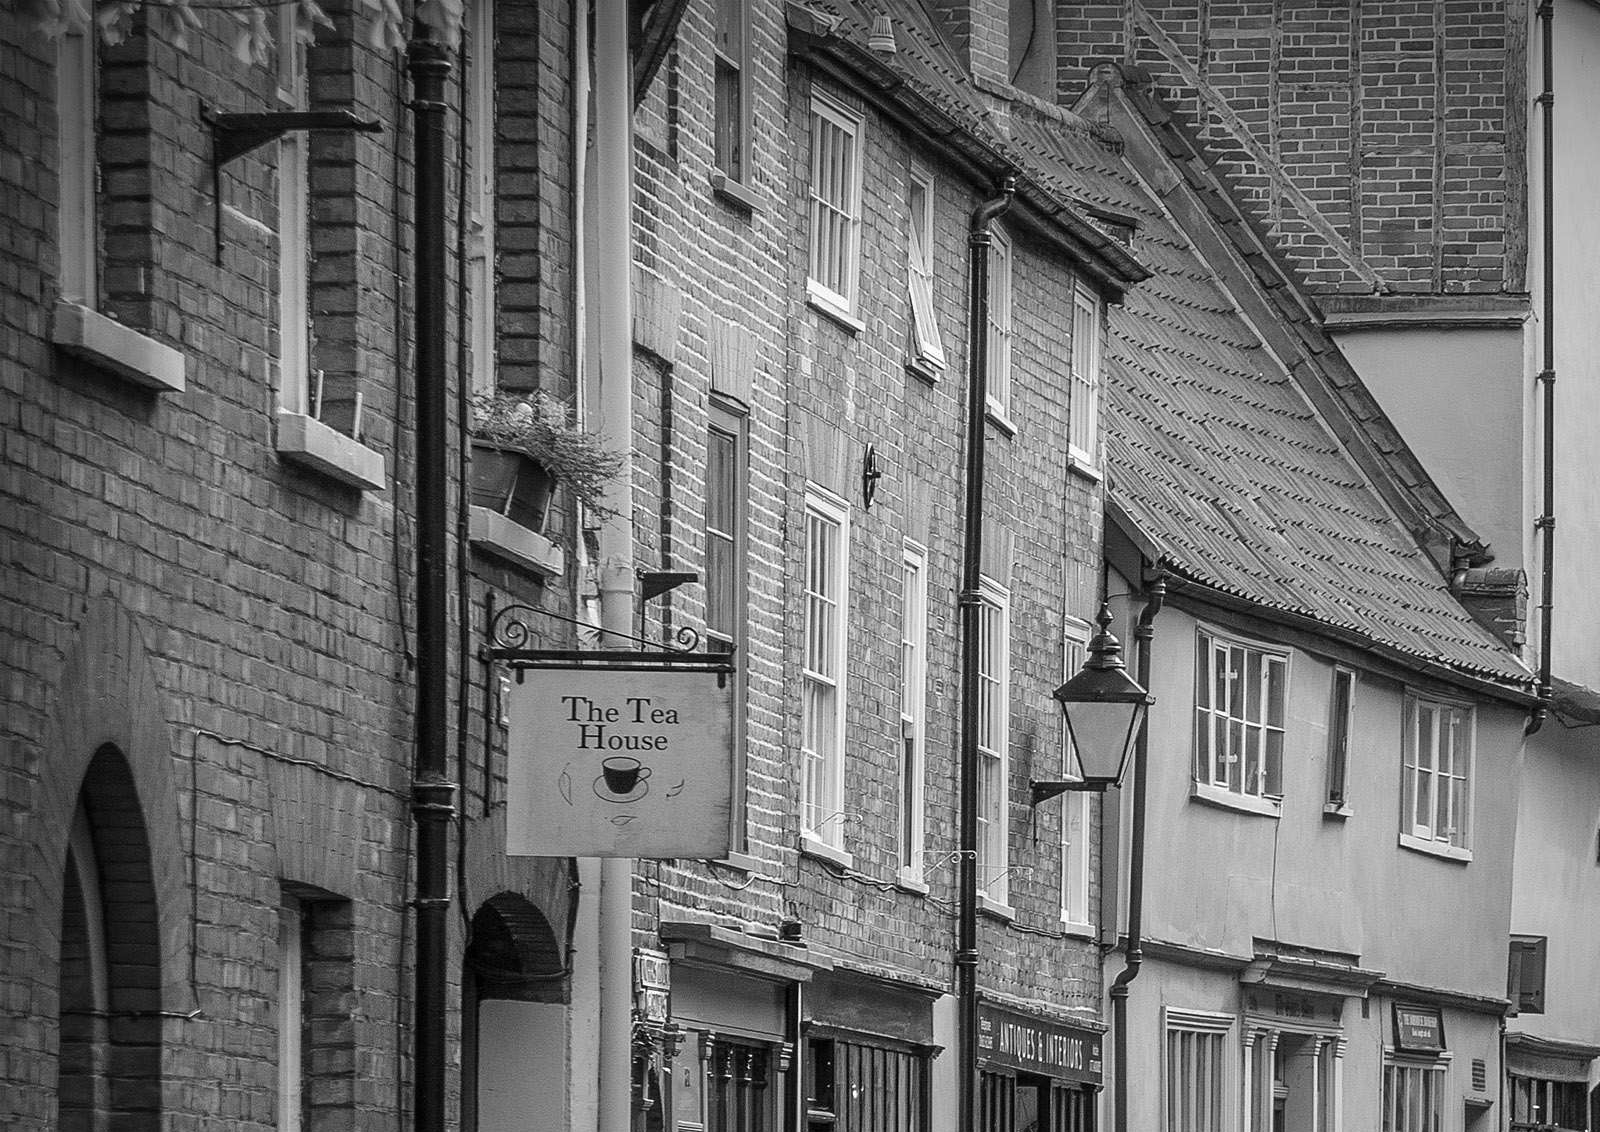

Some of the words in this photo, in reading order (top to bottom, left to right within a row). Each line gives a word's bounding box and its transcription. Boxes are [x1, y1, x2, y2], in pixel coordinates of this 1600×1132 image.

[561, 696, 619, 723] The
[626, 698, 680, 724] Tea
[577, 724, 668, 750] House
[1000, 1021, 1035, 1062] ANTIQUES
[1046, 1033, 1082, 1070] INTERIORS
